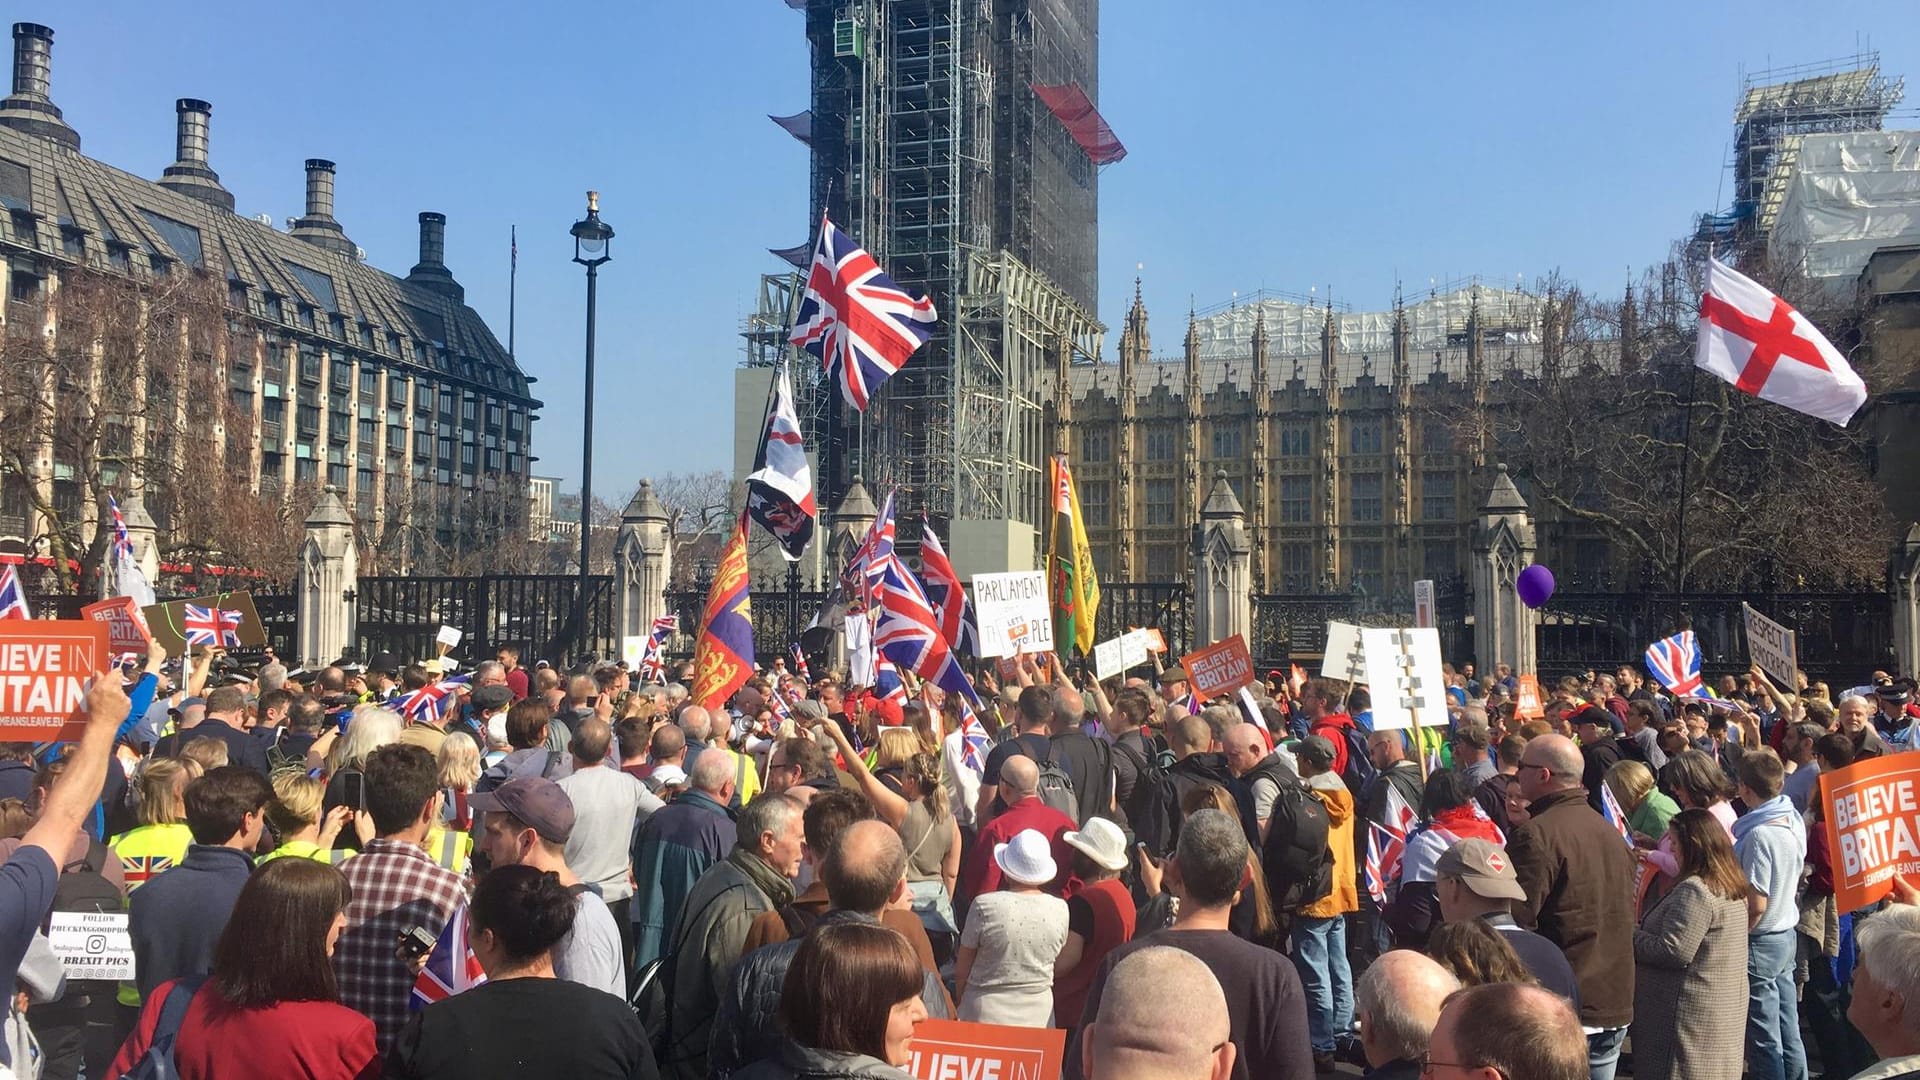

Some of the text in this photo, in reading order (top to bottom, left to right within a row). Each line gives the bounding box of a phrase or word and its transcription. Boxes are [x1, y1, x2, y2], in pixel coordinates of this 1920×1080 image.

[977, 576, 1042, 603] PARLIAMENT
[1032, 618, 1050, 643] PLE
[69, 645, 92, 672] IN
[1191, 649, 1233, 674] BELIEVE
[1196, 658, 1248, 691] BRITAIN
[1835, 780, 1917, 830] BELIEVE
[83, 914, 115, 922] FOLLOW
[63, 956, 104, 965] BREXIT
[105, 957, 129, 965] PICS
[1010, 1060, 1038, 1080] IN
